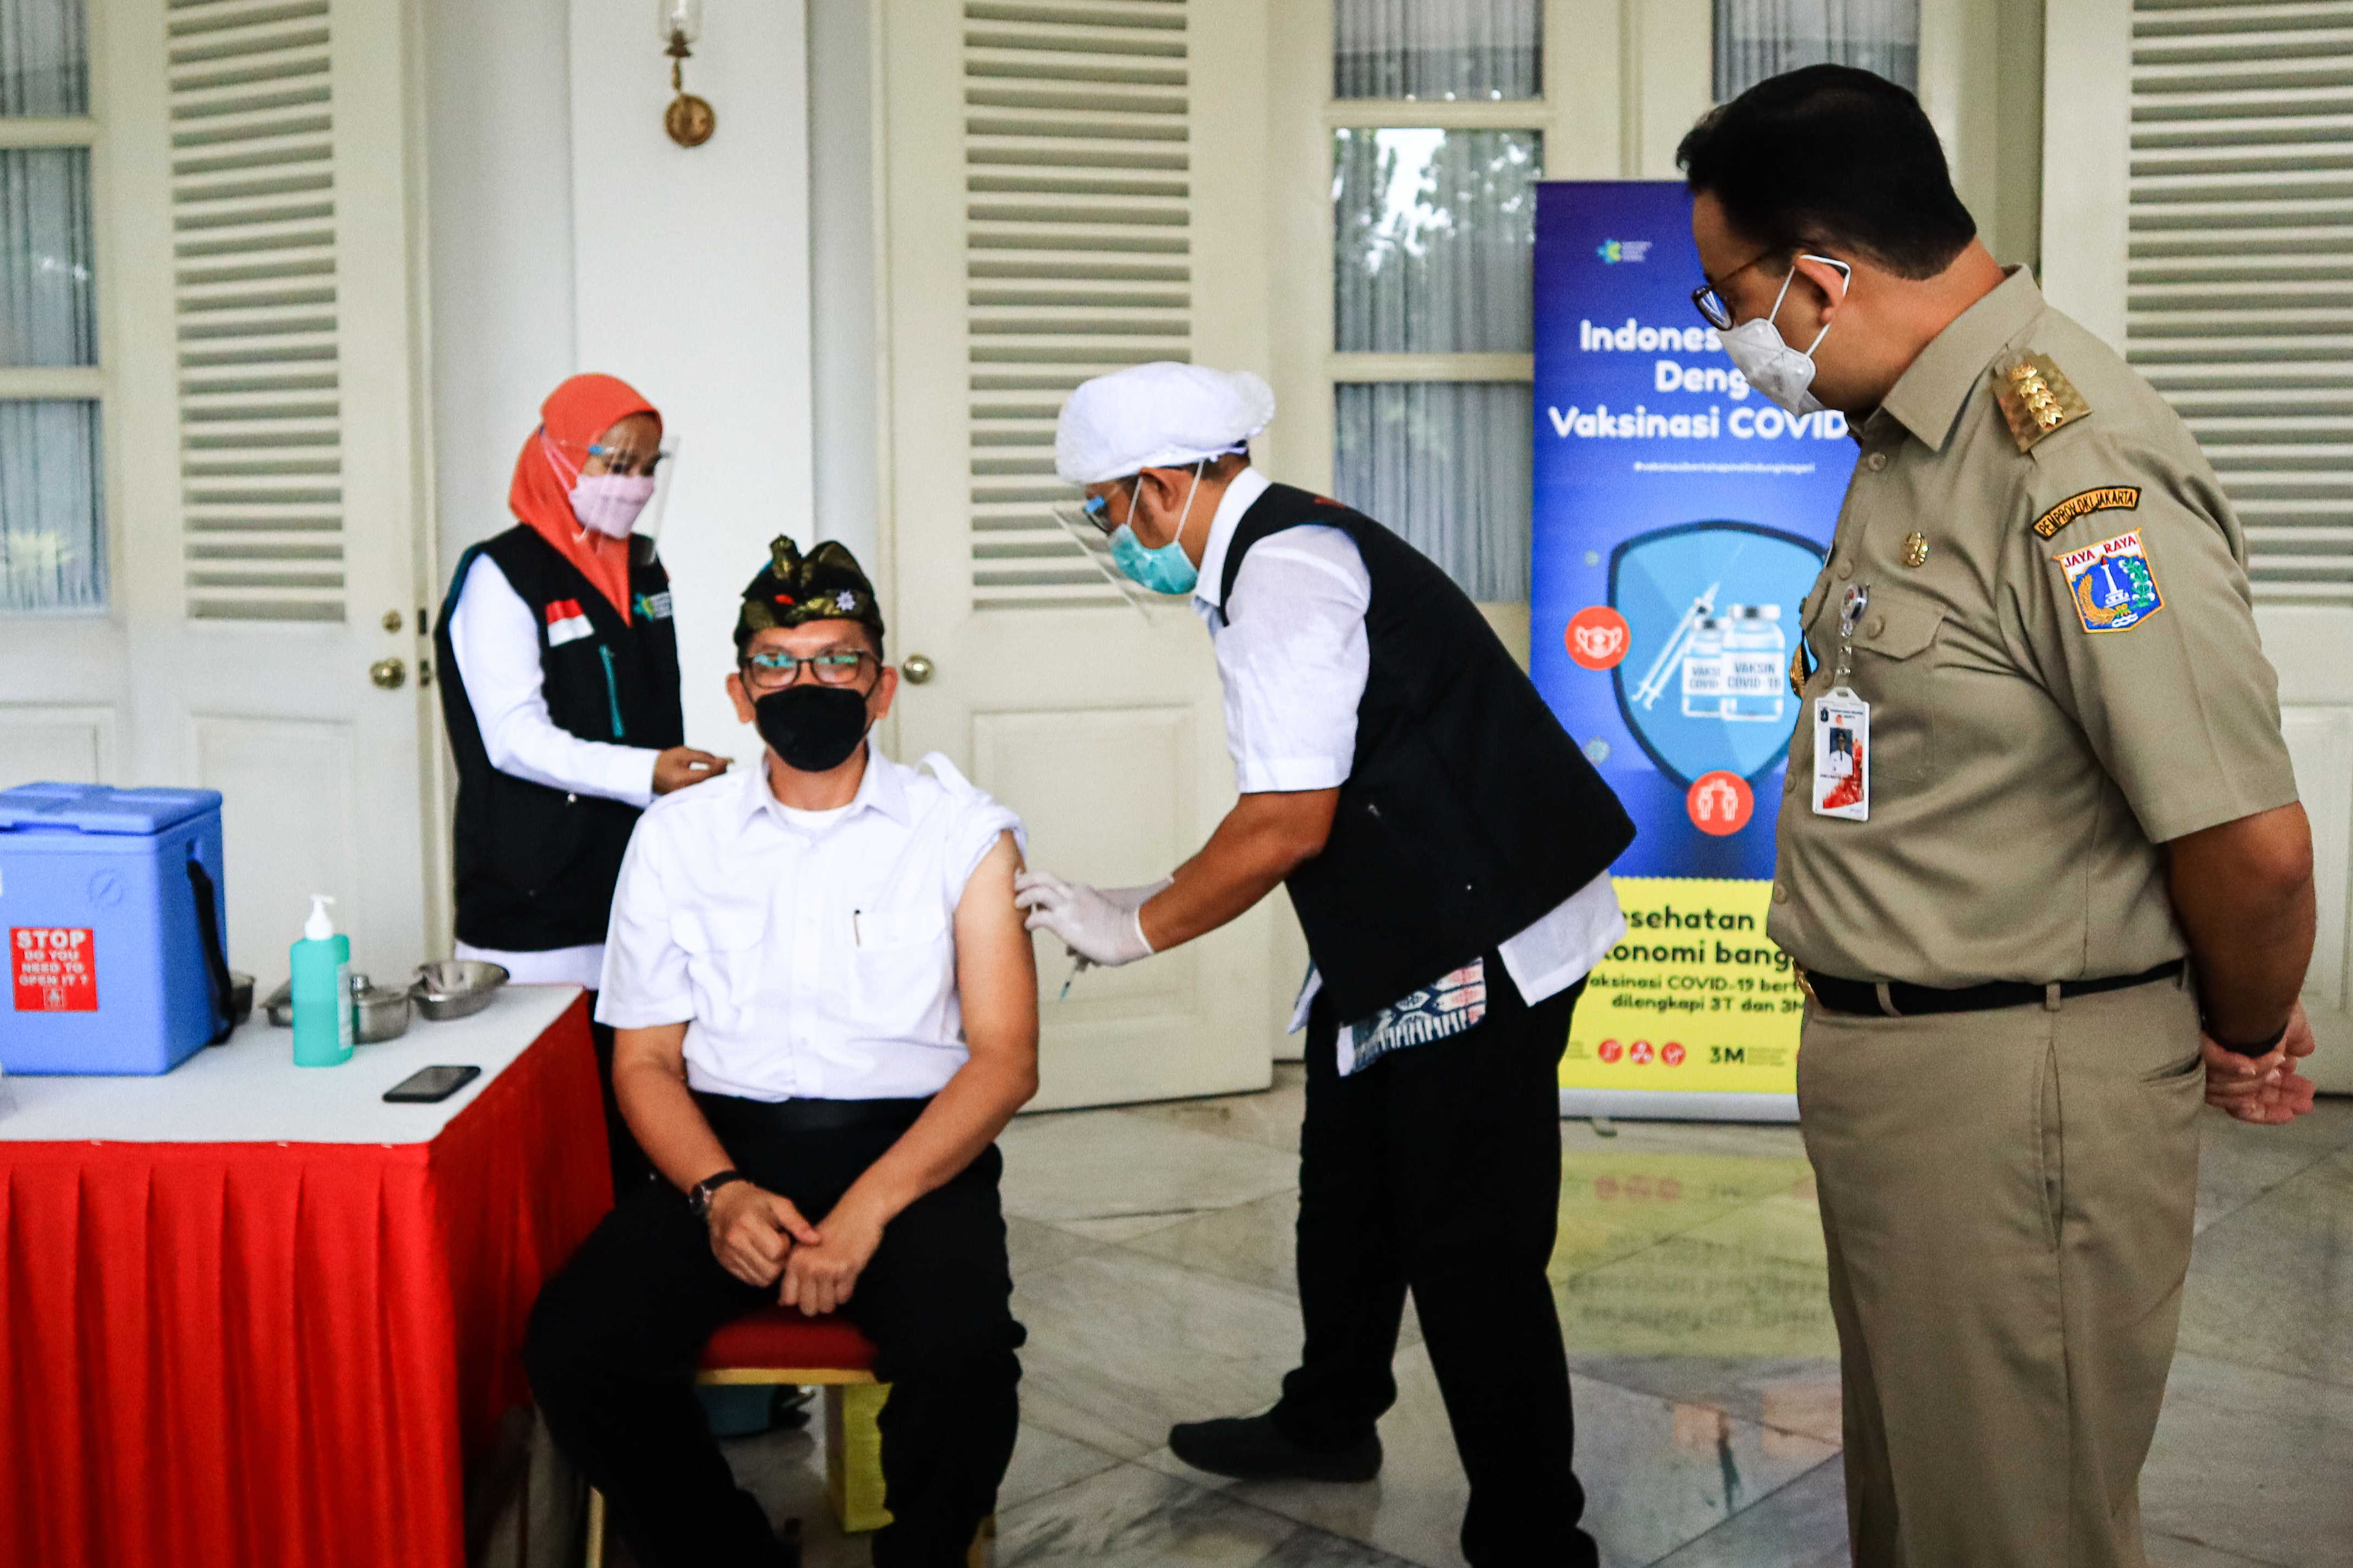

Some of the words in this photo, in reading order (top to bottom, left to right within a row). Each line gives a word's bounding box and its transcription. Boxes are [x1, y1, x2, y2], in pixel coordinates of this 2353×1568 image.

[1548, 405, 1720, 438] Vaksinasi
[1728, 406, 1849, 439] COVID
[2077, 495, 2094, 513] DKI
[2096, 490, 2134, 507] JAKARTA
[2064, 549, 2096, 568] JAYA
[2103, 535, 2136, 554] RAYA
[1734, 662, 1776, 673] VAKSIN
[1622, 905, 1755, 930] sehatan
[16, 930, 86, 949] STOP
[24, 950, 45, 961] DO
[48, 950, 80, 961] YOU
[1604, 939, 1705, 963] onomi
[21, 962, 60, 973] NEED
[64, 962, 85, 974] TO
[19, 973, 58, 987] OPEN
[61, 974, 76, 987] IT
[1612, 993, 1704, 1014] dilengkapi
[1710, 997, 1734, 1012] 3T
[1741, 998, 1775, 1013] dan
[1710, 1046, 1745, 1065] 3M
